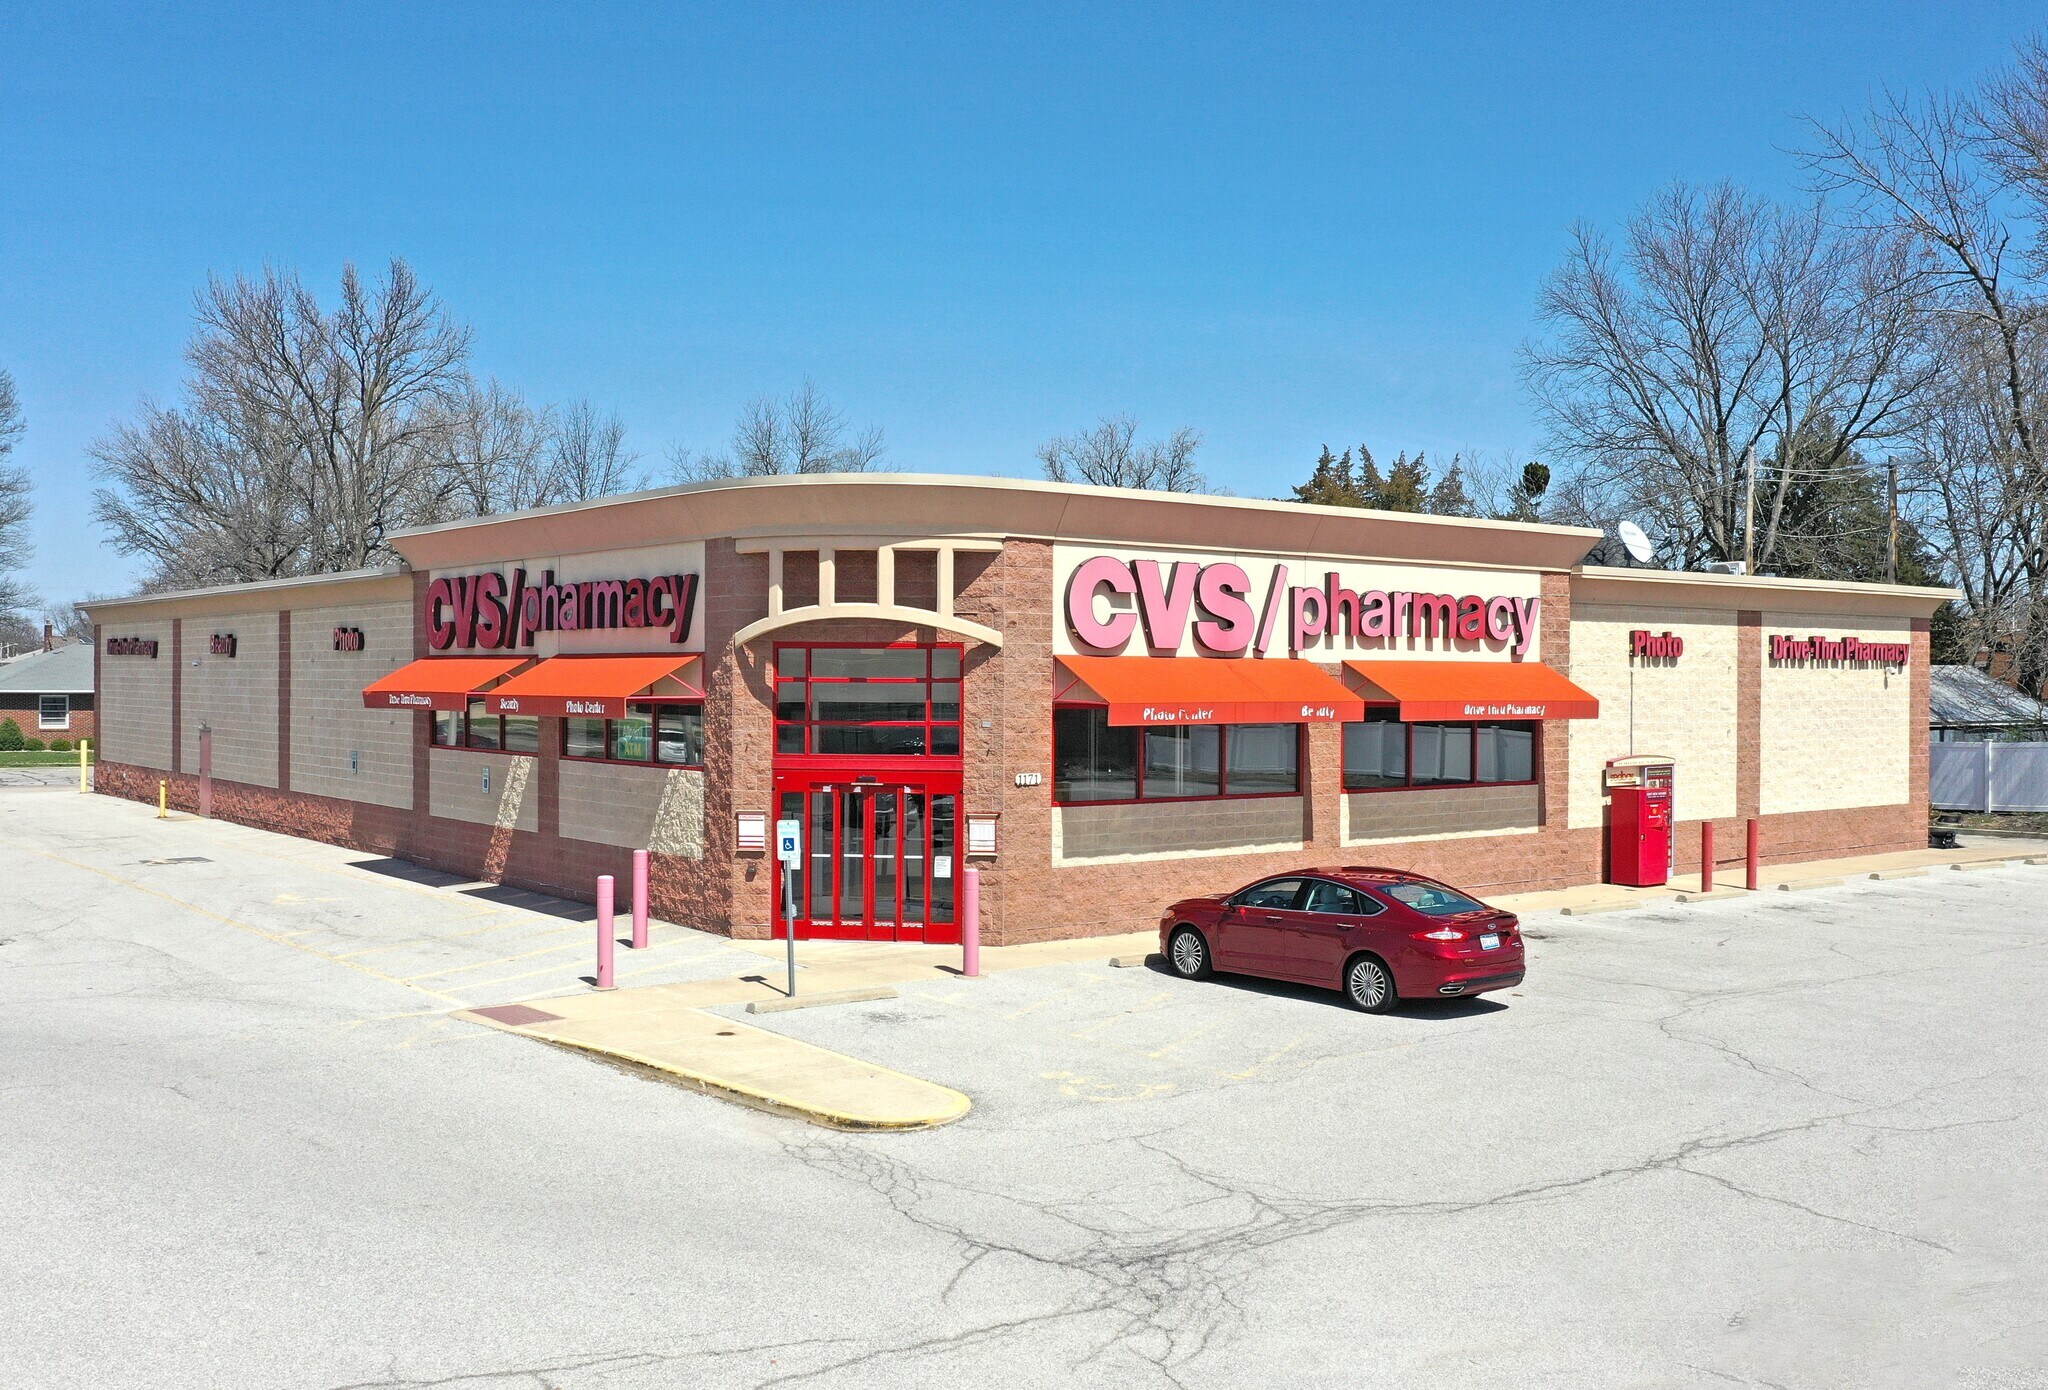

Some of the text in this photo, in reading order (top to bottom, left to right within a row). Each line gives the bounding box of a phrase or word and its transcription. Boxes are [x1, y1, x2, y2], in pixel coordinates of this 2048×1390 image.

[425, 567, 699, 650] CVS/pharmacy
[1066, 556, 1540, 656] CVS/pharmacy
[333, 627, 365, 652] Photo
[1629, 630, 1684, 658] Photo
[1842, 637, 1910, 666] Pharmacy
[566, 700, 584, 713] Photo
[1464, 704, 1485, 715] Drive
[1017, 773, 1040, 786] 1171
